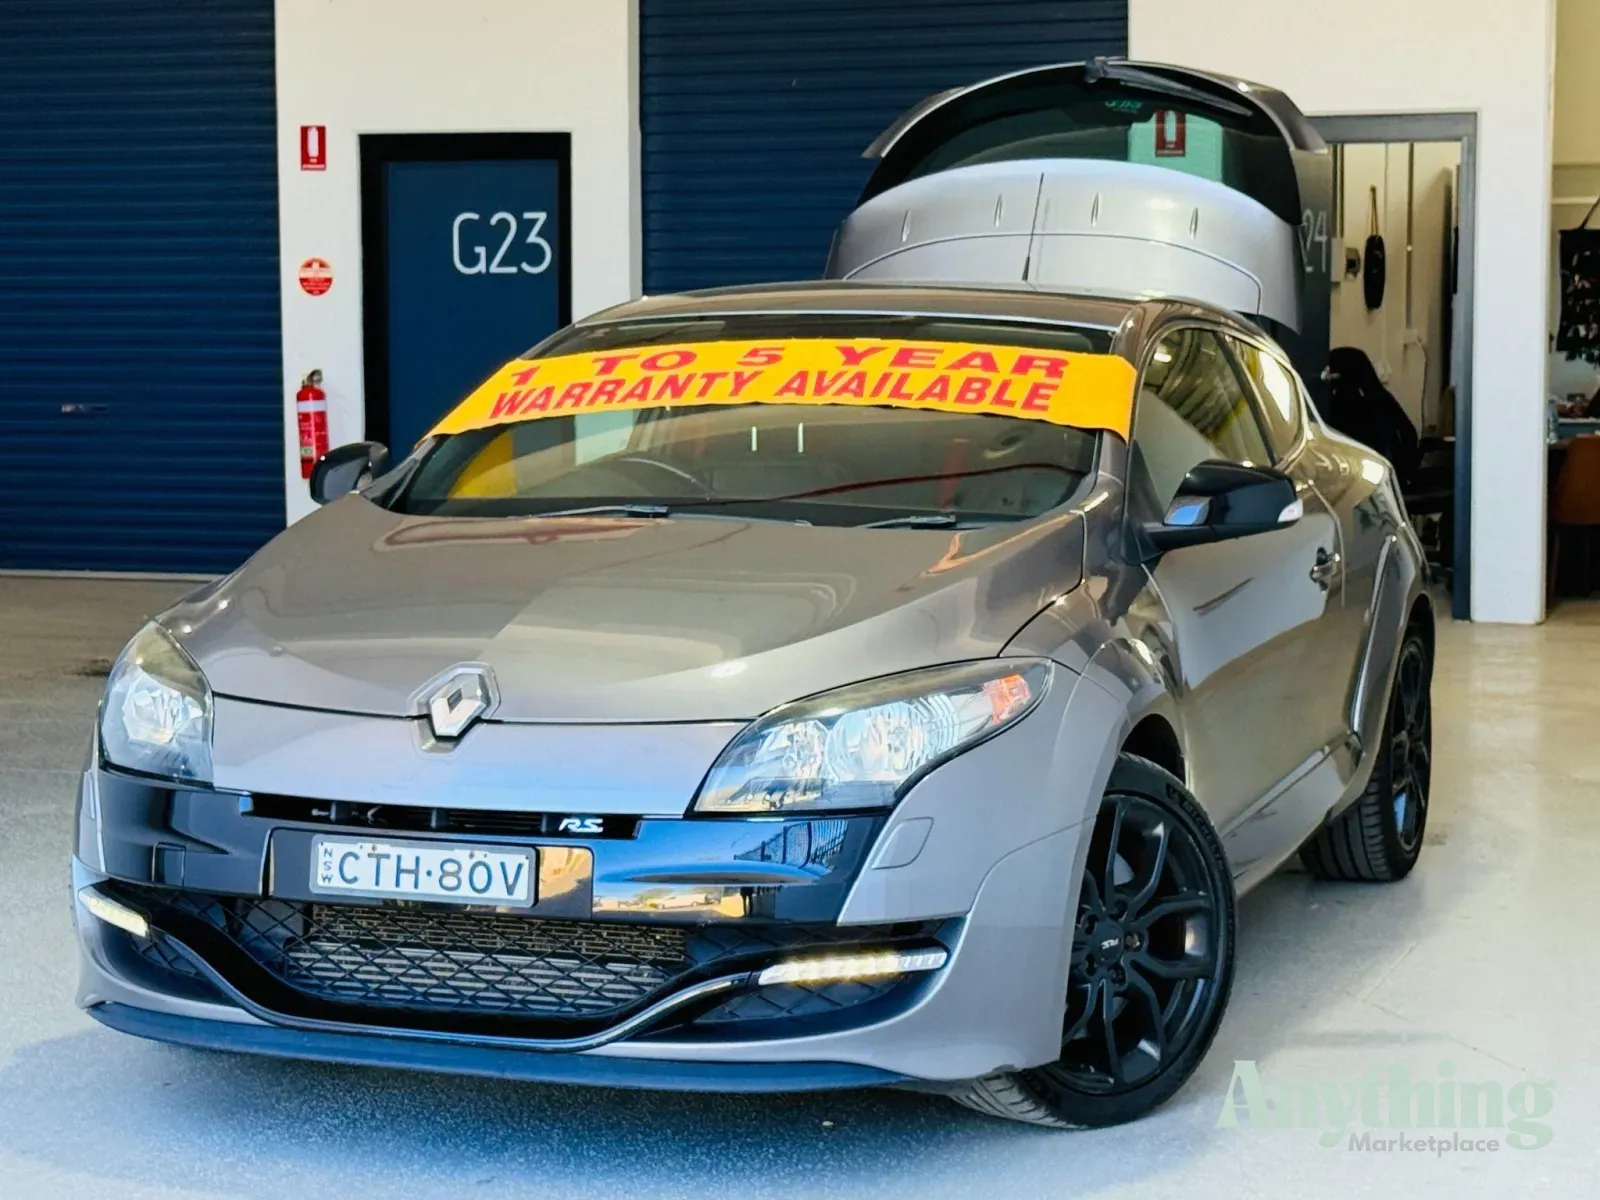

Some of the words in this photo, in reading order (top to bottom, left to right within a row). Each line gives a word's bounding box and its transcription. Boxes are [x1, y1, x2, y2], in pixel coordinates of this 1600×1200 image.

[452, 211, 552, 275] G23
[510, 366, 541, 386] 1
[591, 353, 696, 375] TO
[735, 347, 786, 366] 5
[834, 345, 1070, 379] YEAR
[490, 369, 766, 419] WARRANTY
[773, 369, 1060, 412] AVAILABLE
[558, 818, 604, 834] RS
